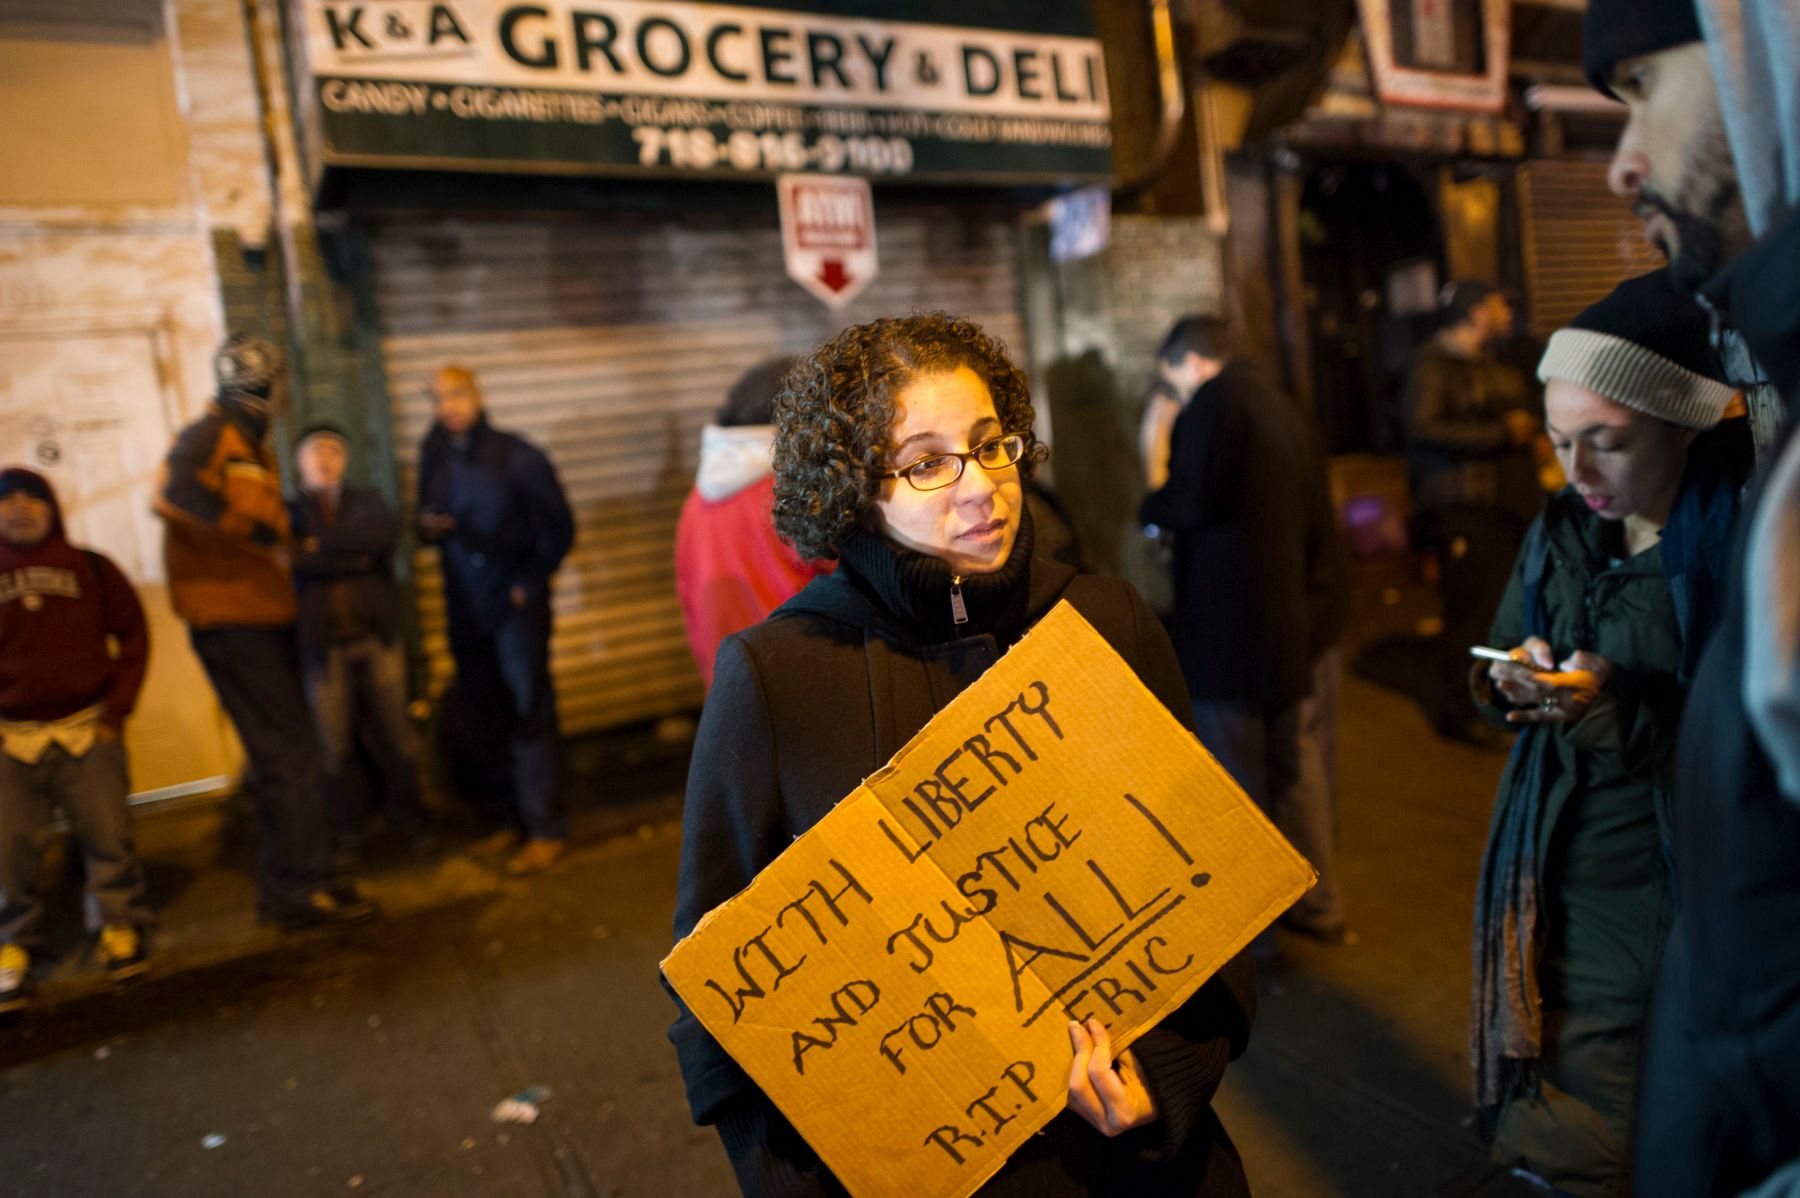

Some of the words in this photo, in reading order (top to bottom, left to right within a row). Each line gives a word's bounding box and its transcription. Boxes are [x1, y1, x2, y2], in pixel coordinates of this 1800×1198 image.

[321, 80, 430, 116] CANDY
[449, 86, 605, 125] CIGARETTES
[325, 7, 371, 50] K
[384, 14, 411, 39] &
[428, 5, 469, 45] A
[499, 6, 895, 91] GROCERY
[914, 50, 939, 86] &
[962, 44, 1099, 103] DELI
[705, 859, 873, 1025] WITH
[878, 681, 1064, 864] LIBERTY
[791, 979, 880, 1075] AND
[886, 802, 1082, 974] JUSTICE
[880, 992, 977, 1075] FOR
[924, 1060, 1038, 1165] R.I.P
[1063, 936, 1194, 1029] ERIC
